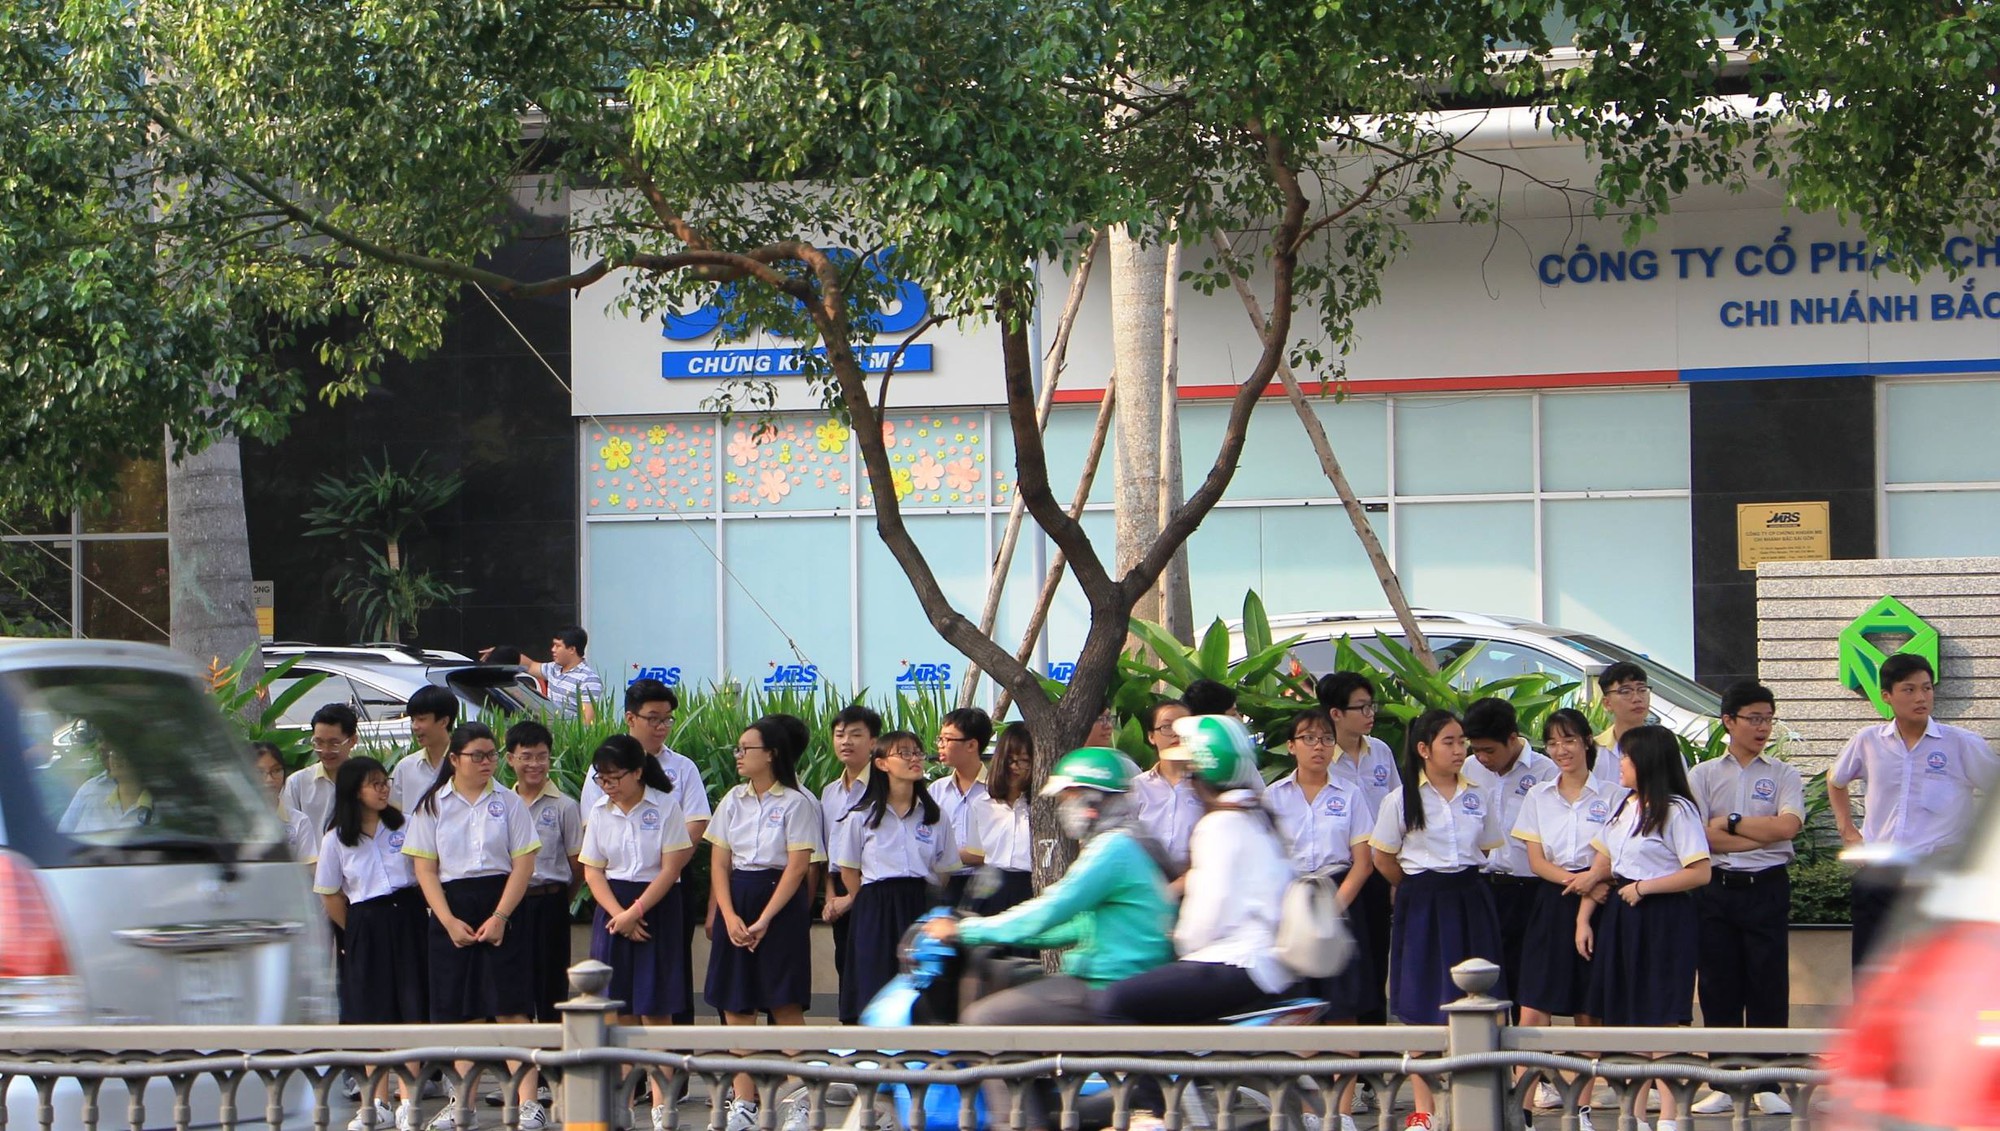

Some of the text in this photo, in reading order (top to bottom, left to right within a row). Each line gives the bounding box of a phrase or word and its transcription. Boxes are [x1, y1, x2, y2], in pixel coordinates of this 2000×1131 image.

[1538, 243, 1659, 285] CÔNG
[1671, 246, 1723, 280] TY
[1735, 226, 1797, 277] CỔ
[1810, 230, 1928, 274] PH
[1719, 277, 2000, 328] CHI NHÁNH BẮC
[687, 352, 771, 374] CHỨNG
[1767, 512, 1800, 523] MBS
[628, 667, 681, 686] MBS
[764, 665, 818, 684] MBS
[896, 663, 951, 682] MBS
